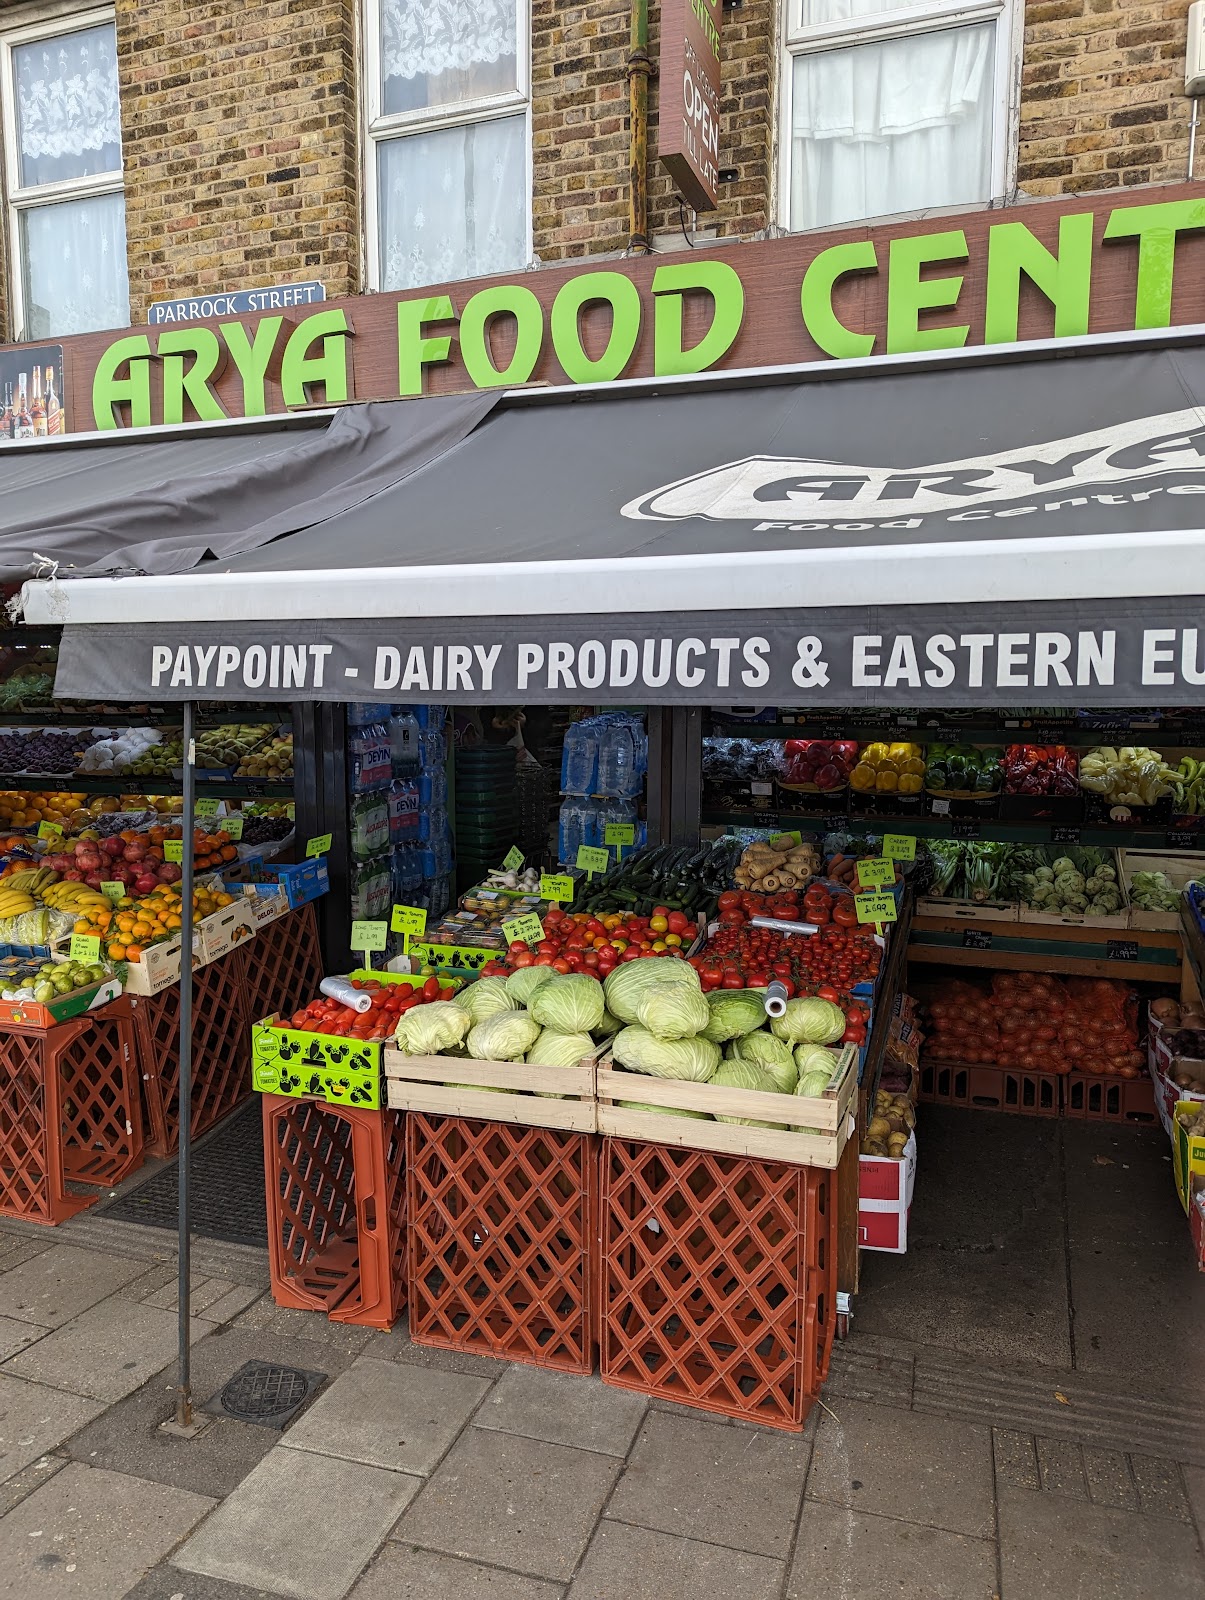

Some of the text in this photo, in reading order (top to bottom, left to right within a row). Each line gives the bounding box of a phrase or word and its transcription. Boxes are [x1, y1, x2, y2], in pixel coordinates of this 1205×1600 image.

[684, 69, 718, 162] OPEN
[682, 117, 717, 195] TILL LATE
[92, 198, 1205, 431] ARYA FOOD CENT
[156, 296, 238, 324] PARROCK
[752, 485, 1205, 532] Food Centre
[151, 644, 332, 688] PAYPOINT
[374, 643, 502, 691] DAIRY
[517, 636, 771, 692] PRODUCTS
[792, 636, 830, 688] &
[852, 630, 1116, 688] EASTERN
[1142, 628, 1205, 686] EU
[368, 748, 391, 764] DEVIN
[396, 797, 417, 812] DEVIN
[258, 908, 274, 921] DELOS
